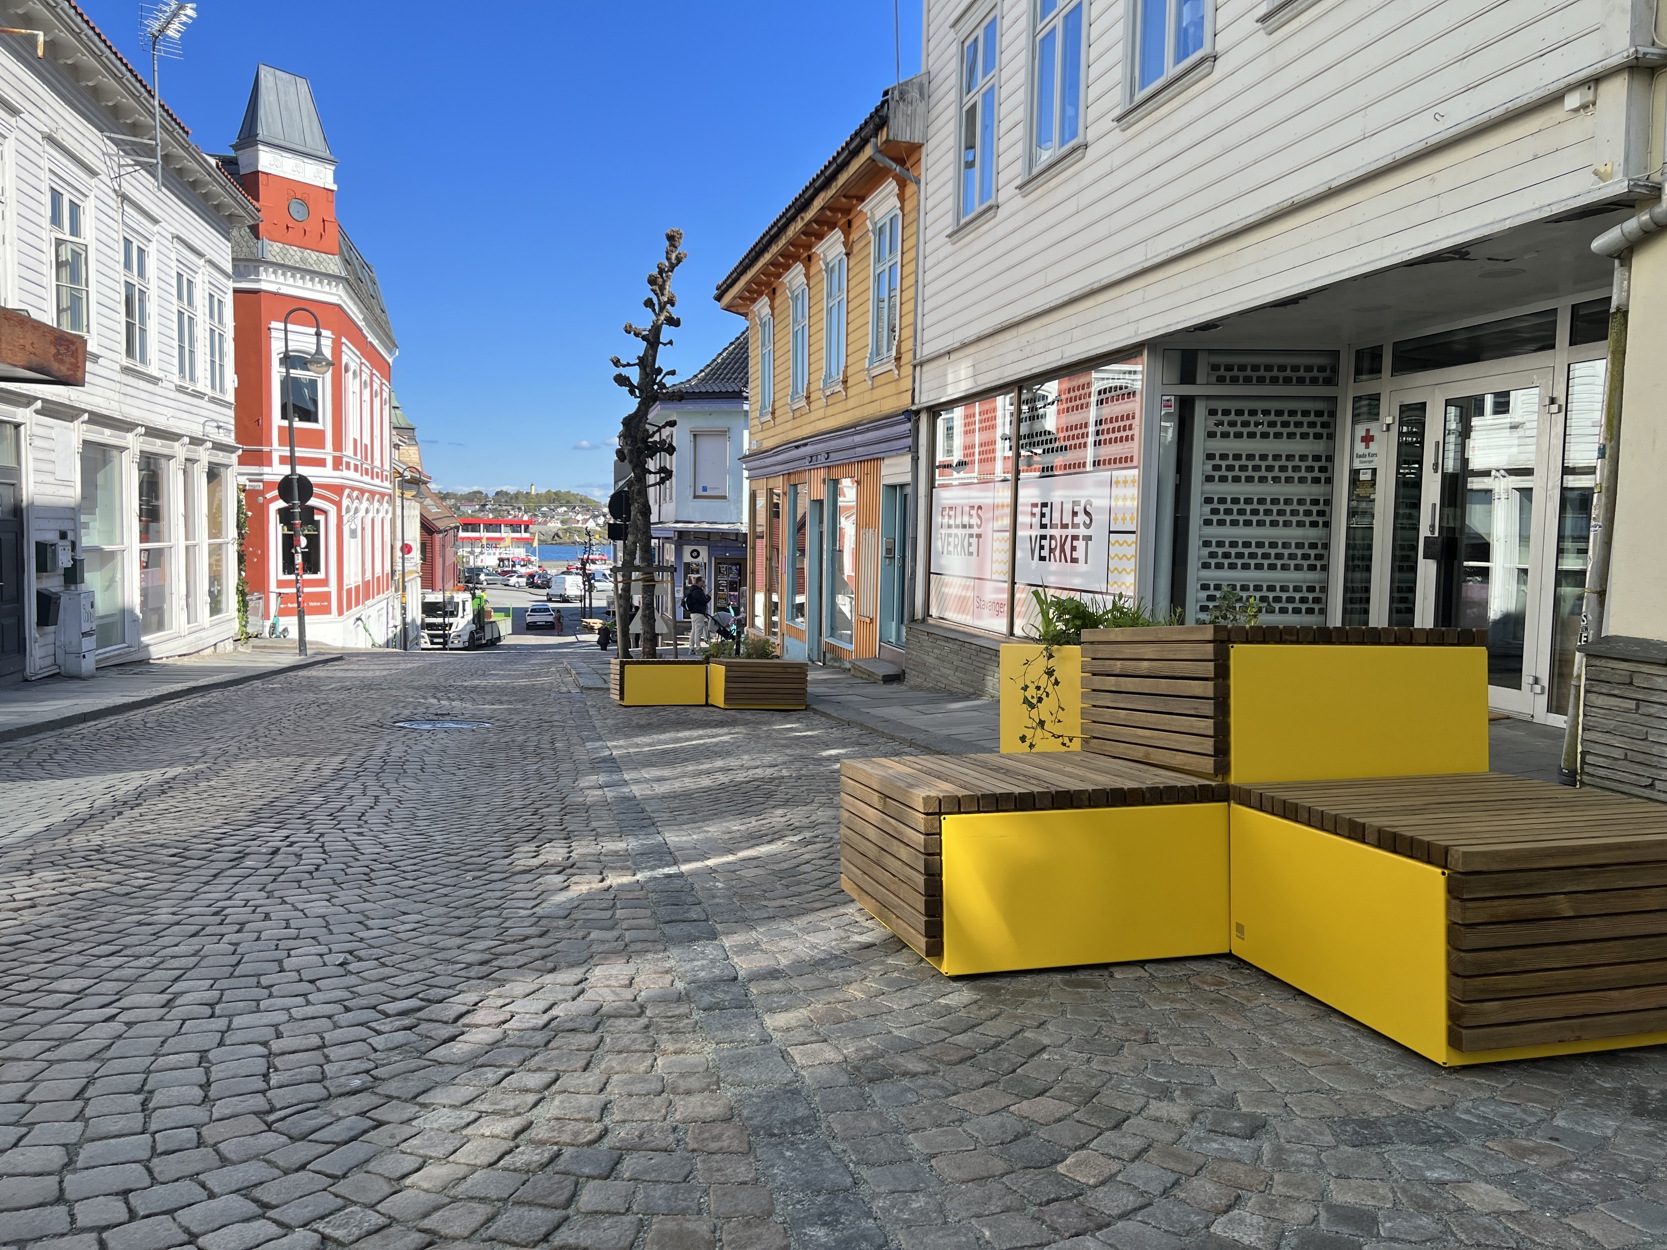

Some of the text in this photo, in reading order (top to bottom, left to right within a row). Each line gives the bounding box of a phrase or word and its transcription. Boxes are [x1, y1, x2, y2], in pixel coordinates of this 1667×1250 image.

[940, 505, 983, 529] FELLES
[1029, 499, 1094, 530] FELLES
[940, 532, 983, 557] VERKET
[1029, 533, 1093, 564] VERKET
[976, 595, 1006, 617] Stavanger
